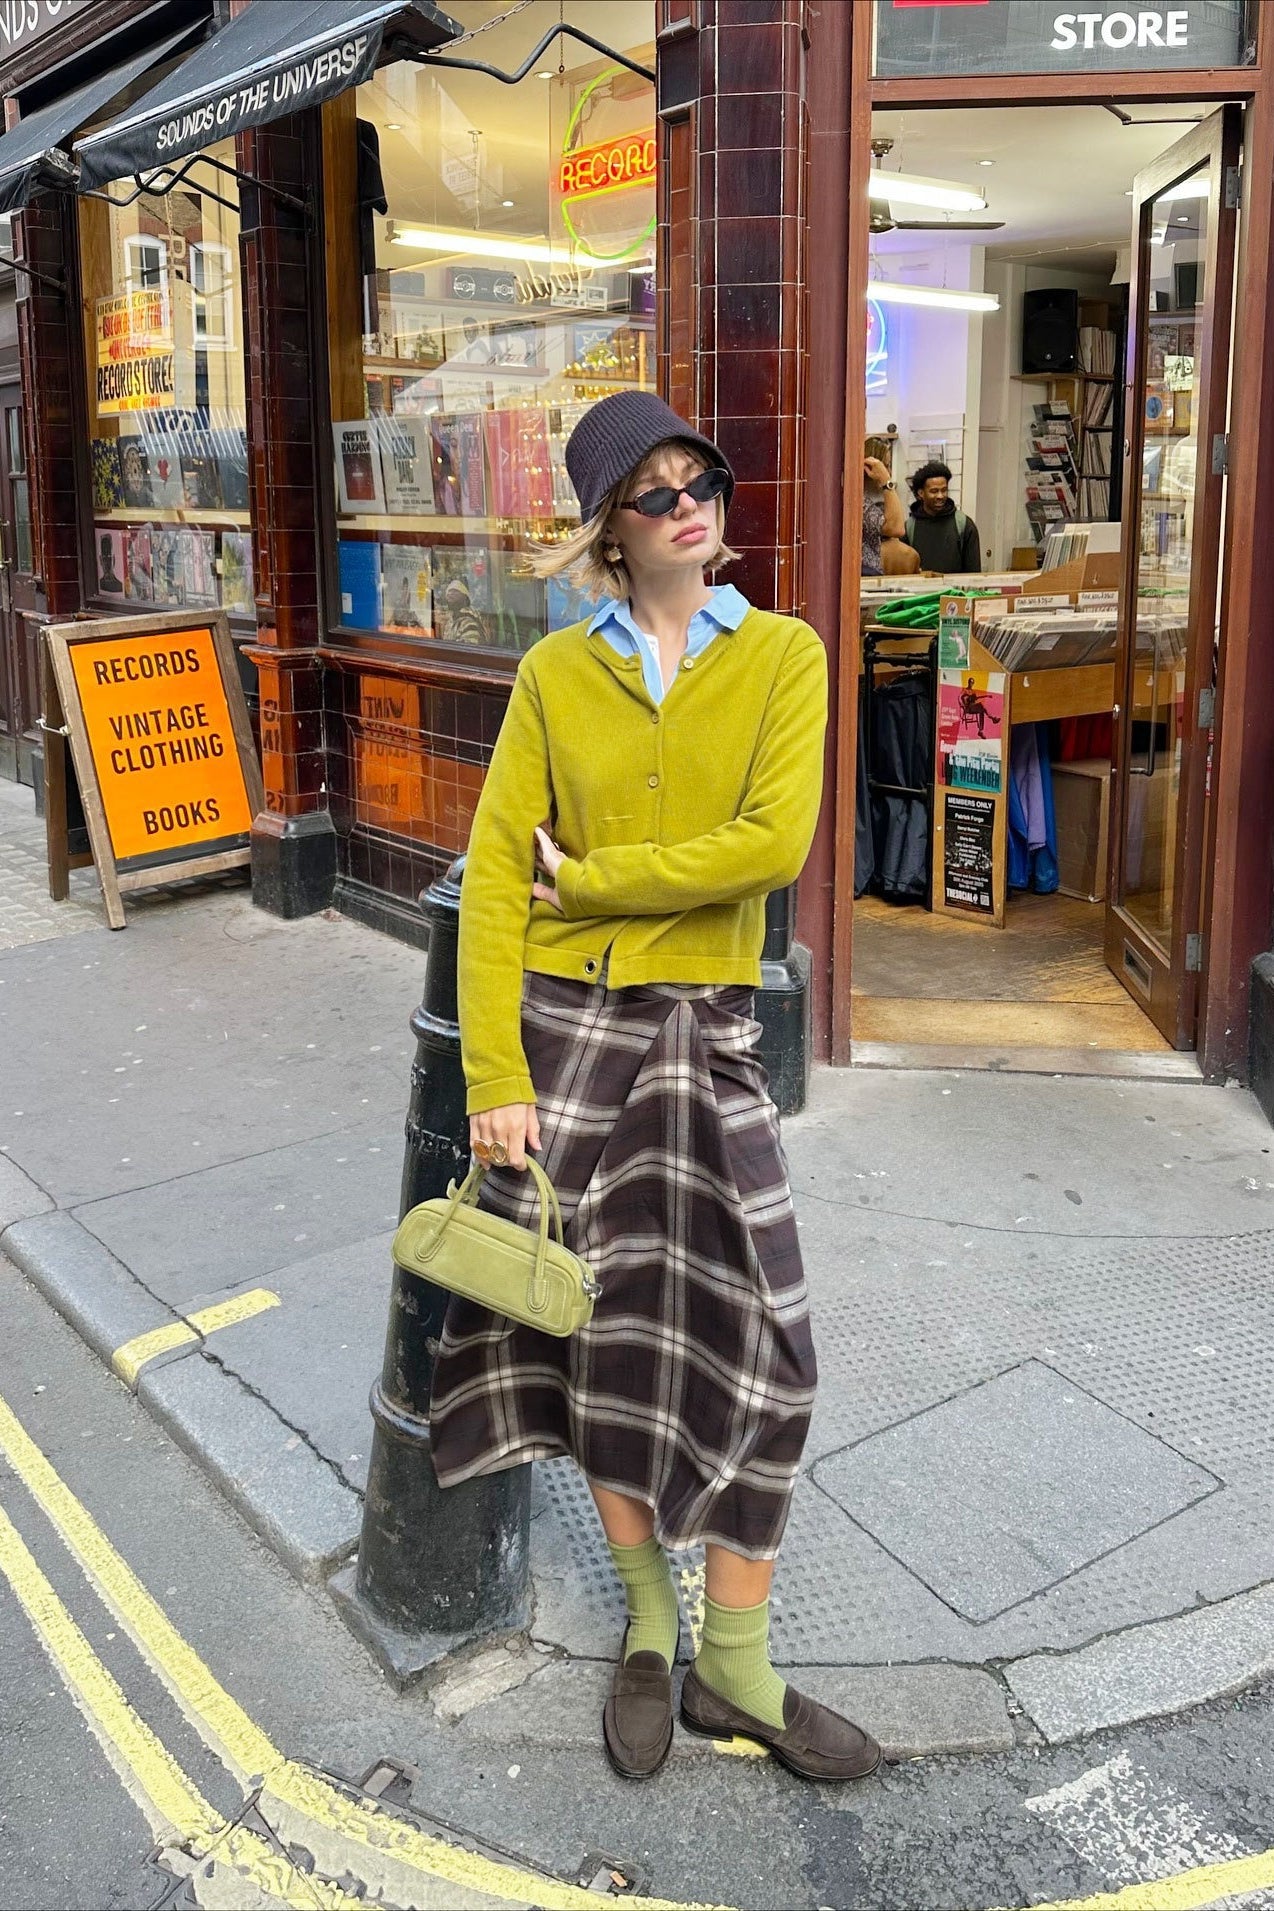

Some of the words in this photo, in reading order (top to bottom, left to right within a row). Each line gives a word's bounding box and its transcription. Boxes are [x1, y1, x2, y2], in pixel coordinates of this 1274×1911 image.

[1050, 10, 1189, 50] STORE
[156, 102, 215, 150] SOUNDS
[216, 93, 238, 125] OF
[238, 79, 270, 117] THE
[272, 34, 368, 103] UNIVERSE
[97, 360, 133, 401] RECORD
[132, 354, 174, 397] STORE!
[93, 648, 200, 686] RECORDS
[109, 703, 209, 740] VINTAGE
[110, 733, 224, 774] CLOTHING
[143, 797, 220, 835] BOOKS
[947, 796, 975, 808] MEMBERS
[976, 801, 992, 810] ONLY
